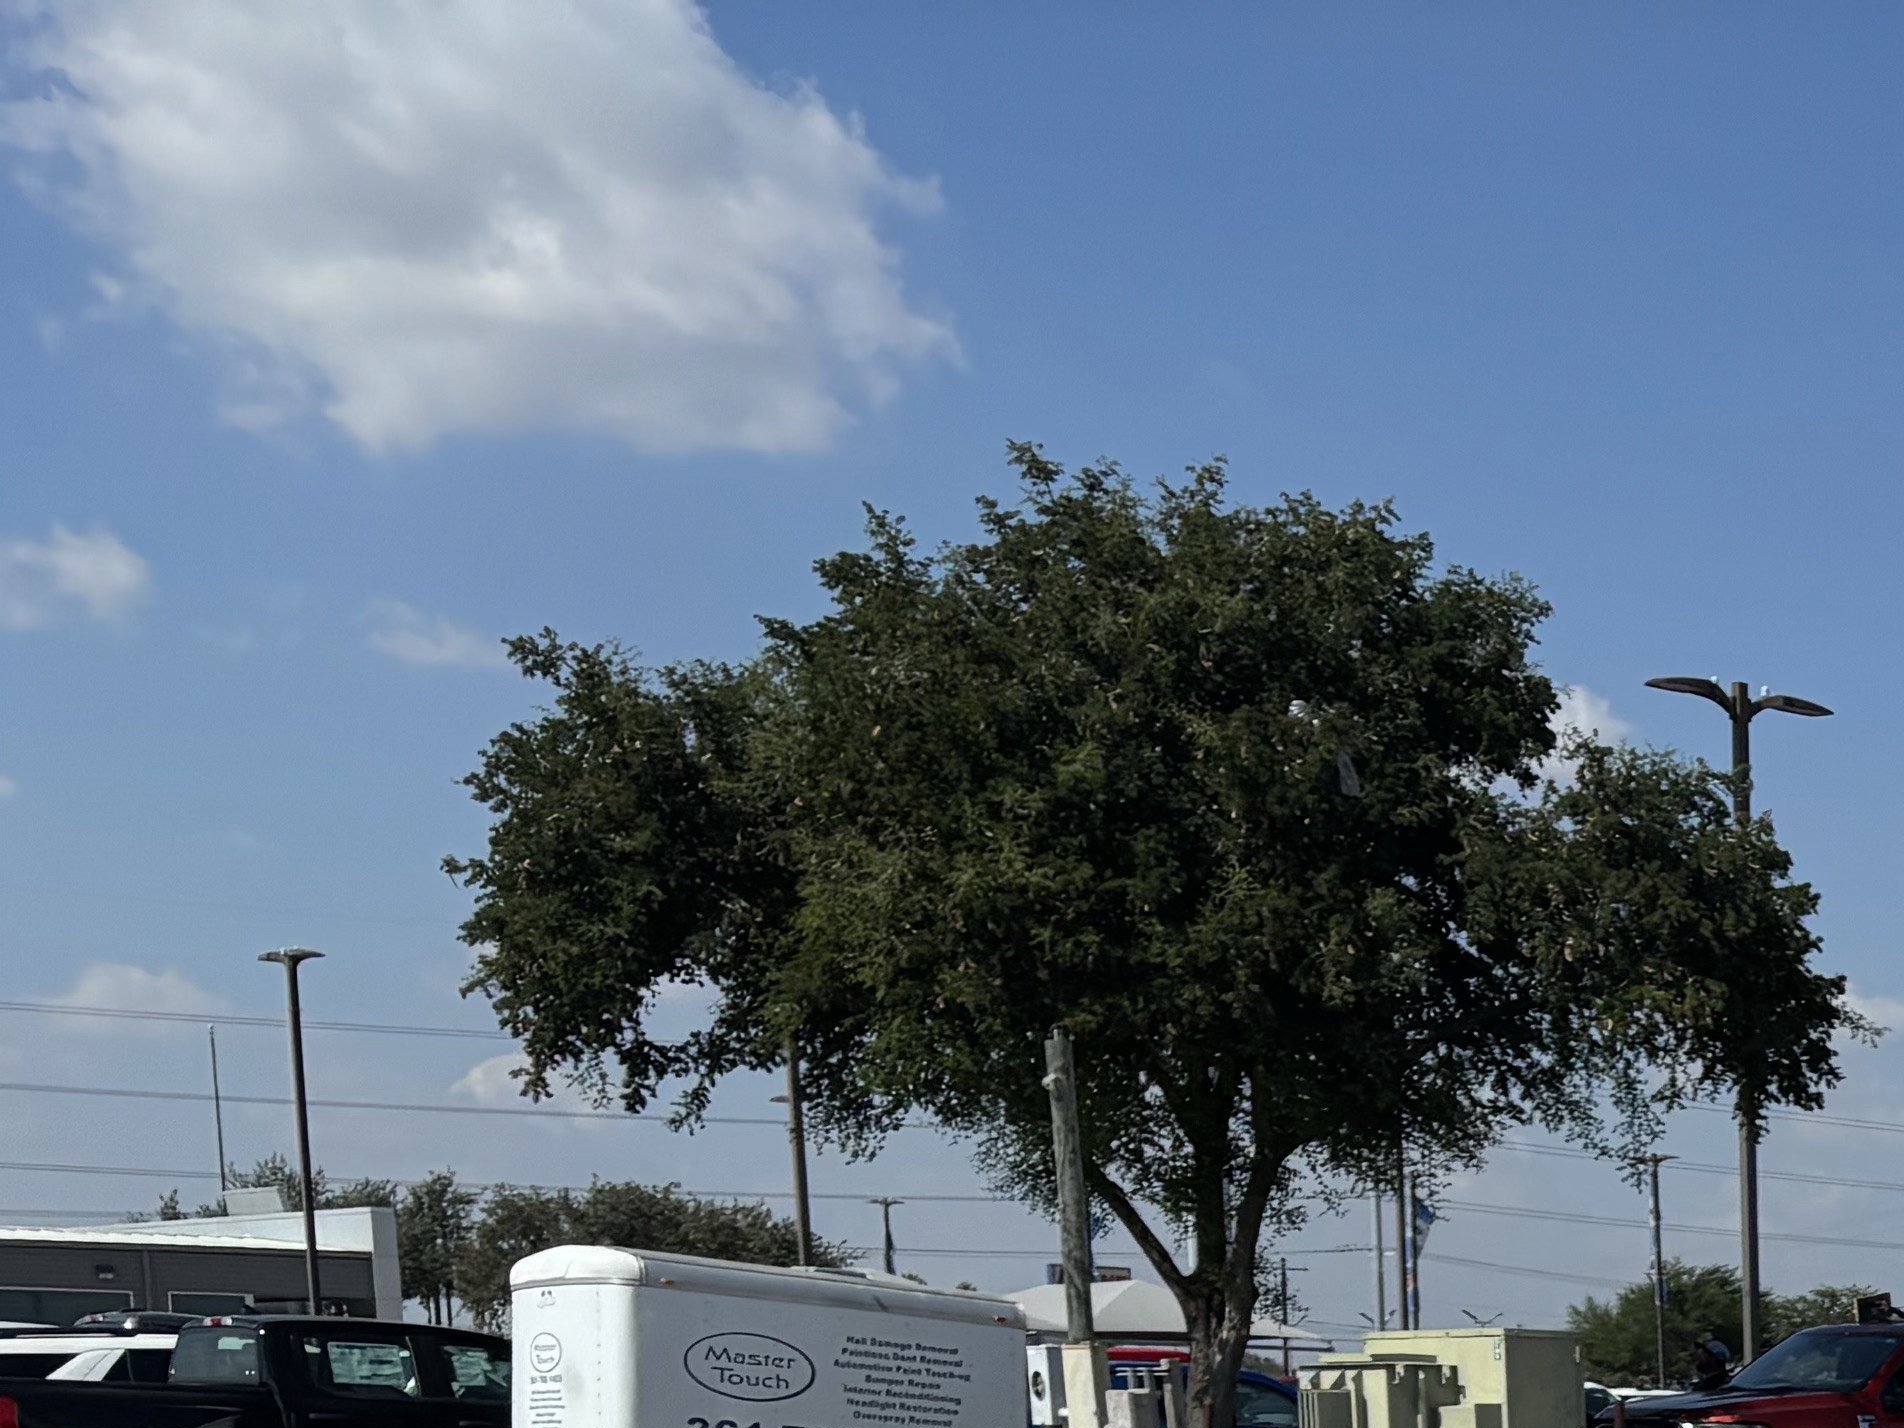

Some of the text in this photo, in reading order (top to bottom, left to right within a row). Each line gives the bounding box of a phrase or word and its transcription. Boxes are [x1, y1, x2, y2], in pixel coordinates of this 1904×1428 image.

[915, 1343, 959, 1355] Removal
[704, 1345, 796, 1369] Master
[919, 1355, 964, 1368] Removal
[711, 1366, 790, 1390] Touch
[908, 1415, 953, 1427] Removal
